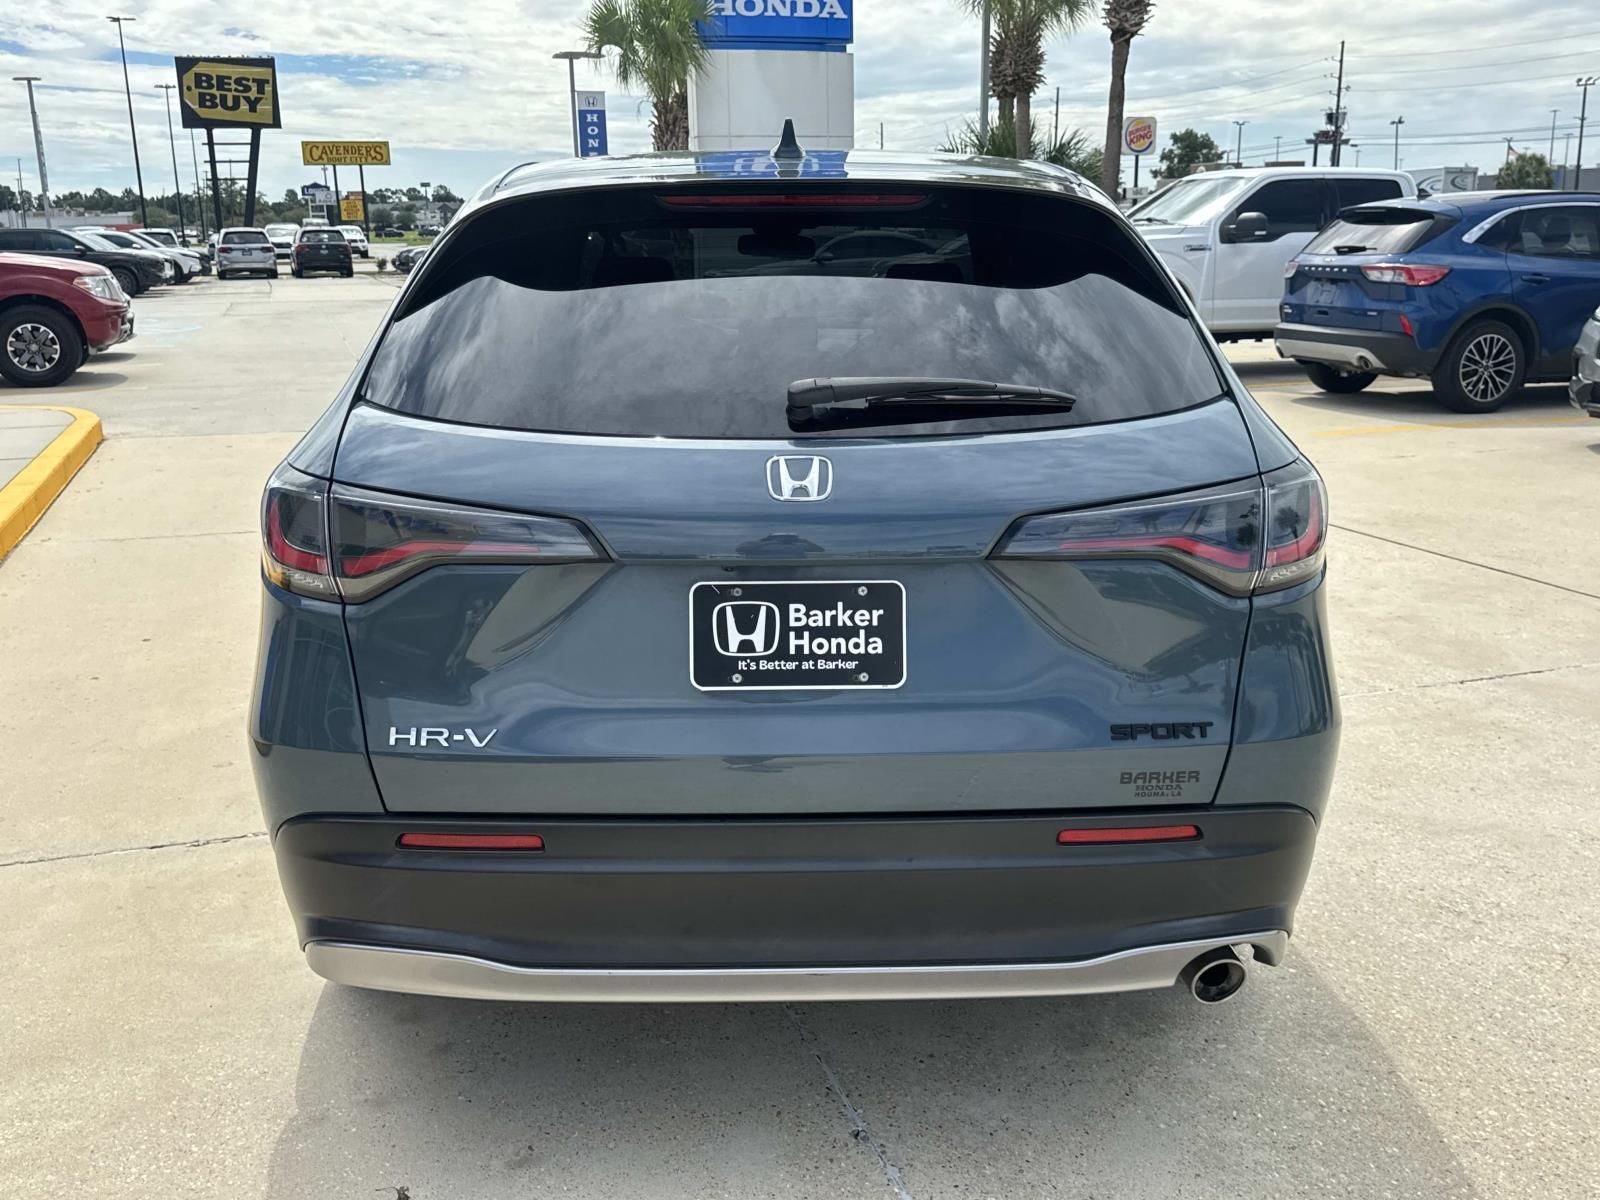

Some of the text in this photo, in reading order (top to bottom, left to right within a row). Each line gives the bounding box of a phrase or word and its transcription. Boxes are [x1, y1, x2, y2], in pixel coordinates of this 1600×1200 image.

[705, 0, 848, 19] HONDA
[194, 72, 270, 95] BEST
[198, 92, 263, 113] BUY
[586, 113, 600, 156] HON
[1128, 124, 1152, 136] BURGER
[1128, 131, 1152, 145] KING
[309, 144, 384, 162] CAVENDER'S
[788, 601, 884, 627] Barker
[788, 629, 883, 655] Honda
[738, 658, 859, 670] It's Better at Barker
[388, 726, 498, 747] HR-V
[1110, 722, 1213, 741] SPORT
[1120, 770, 1200, 785] BARKER
[1135, 784, 1183, 792] HONDA
